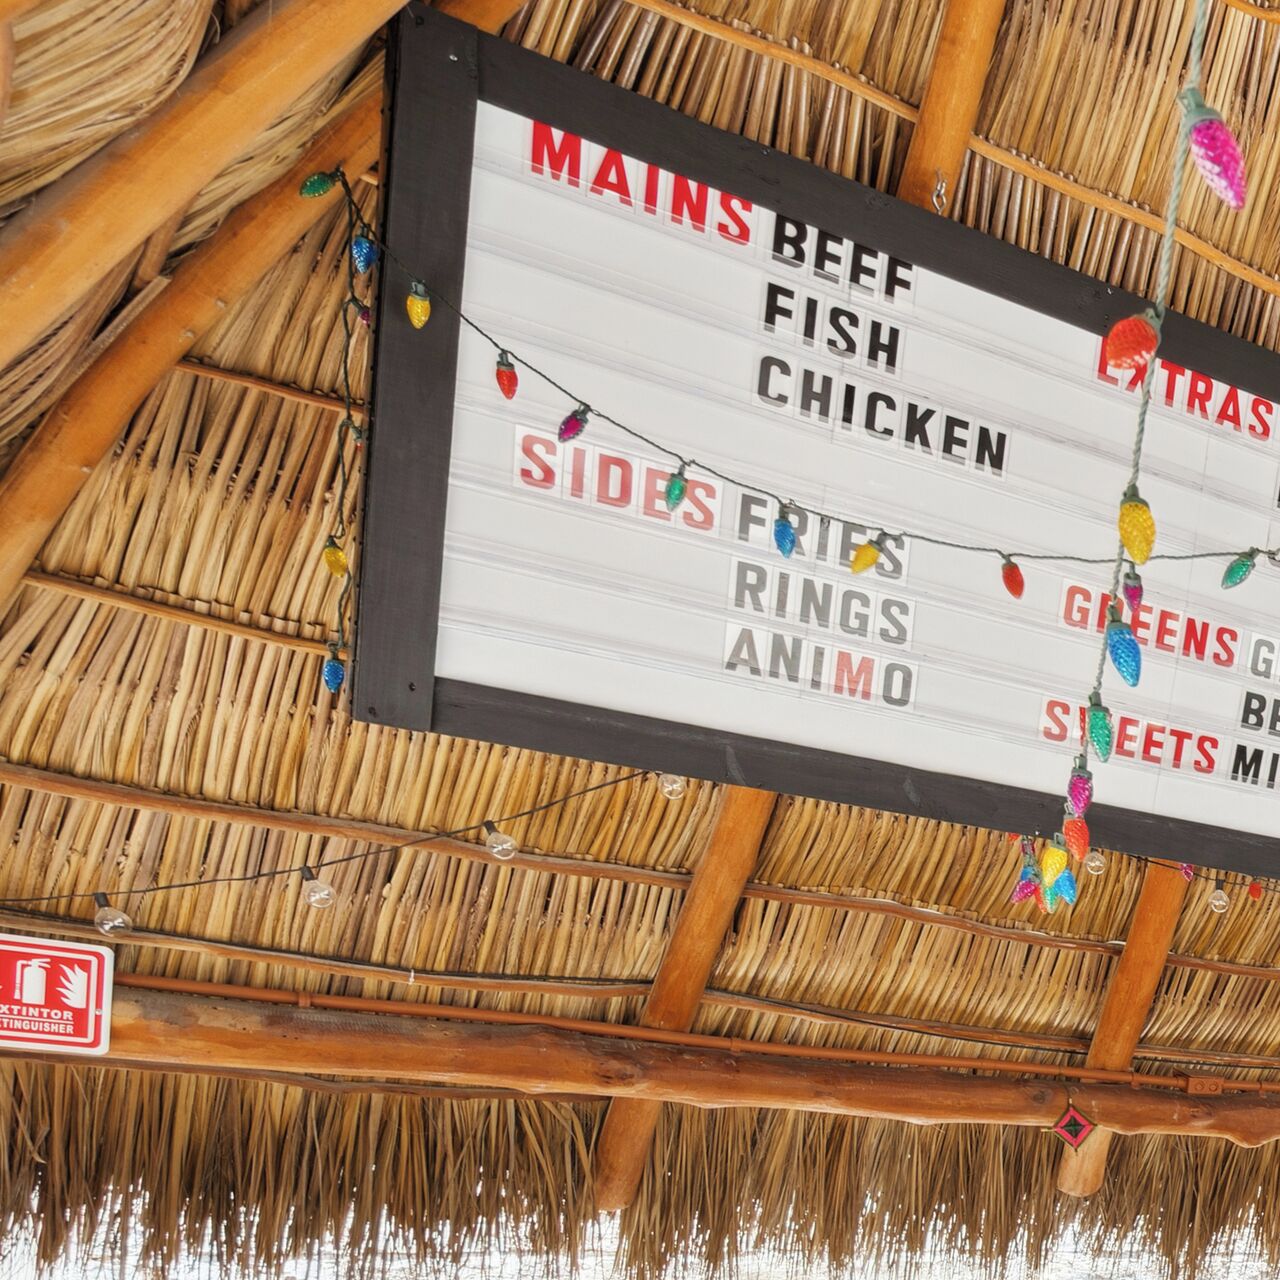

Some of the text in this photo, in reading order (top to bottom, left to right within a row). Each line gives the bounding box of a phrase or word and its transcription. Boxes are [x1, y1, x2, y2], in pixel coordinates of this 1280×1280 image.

[531, 119, 913, 304] MAINS BEEF
[763, 281, 900, 374] FISH
[758, 355, 1007, 478] CHICKEN
[520, 433, 906, 580] SIDES FRIES
[734, 560, 910, 645] RINGS
[724, 627, 913, 708] ANIMO
[1043, 699, 1219, 774] SEETS
[0, 1018, 74, 1034] TINGUISHER
